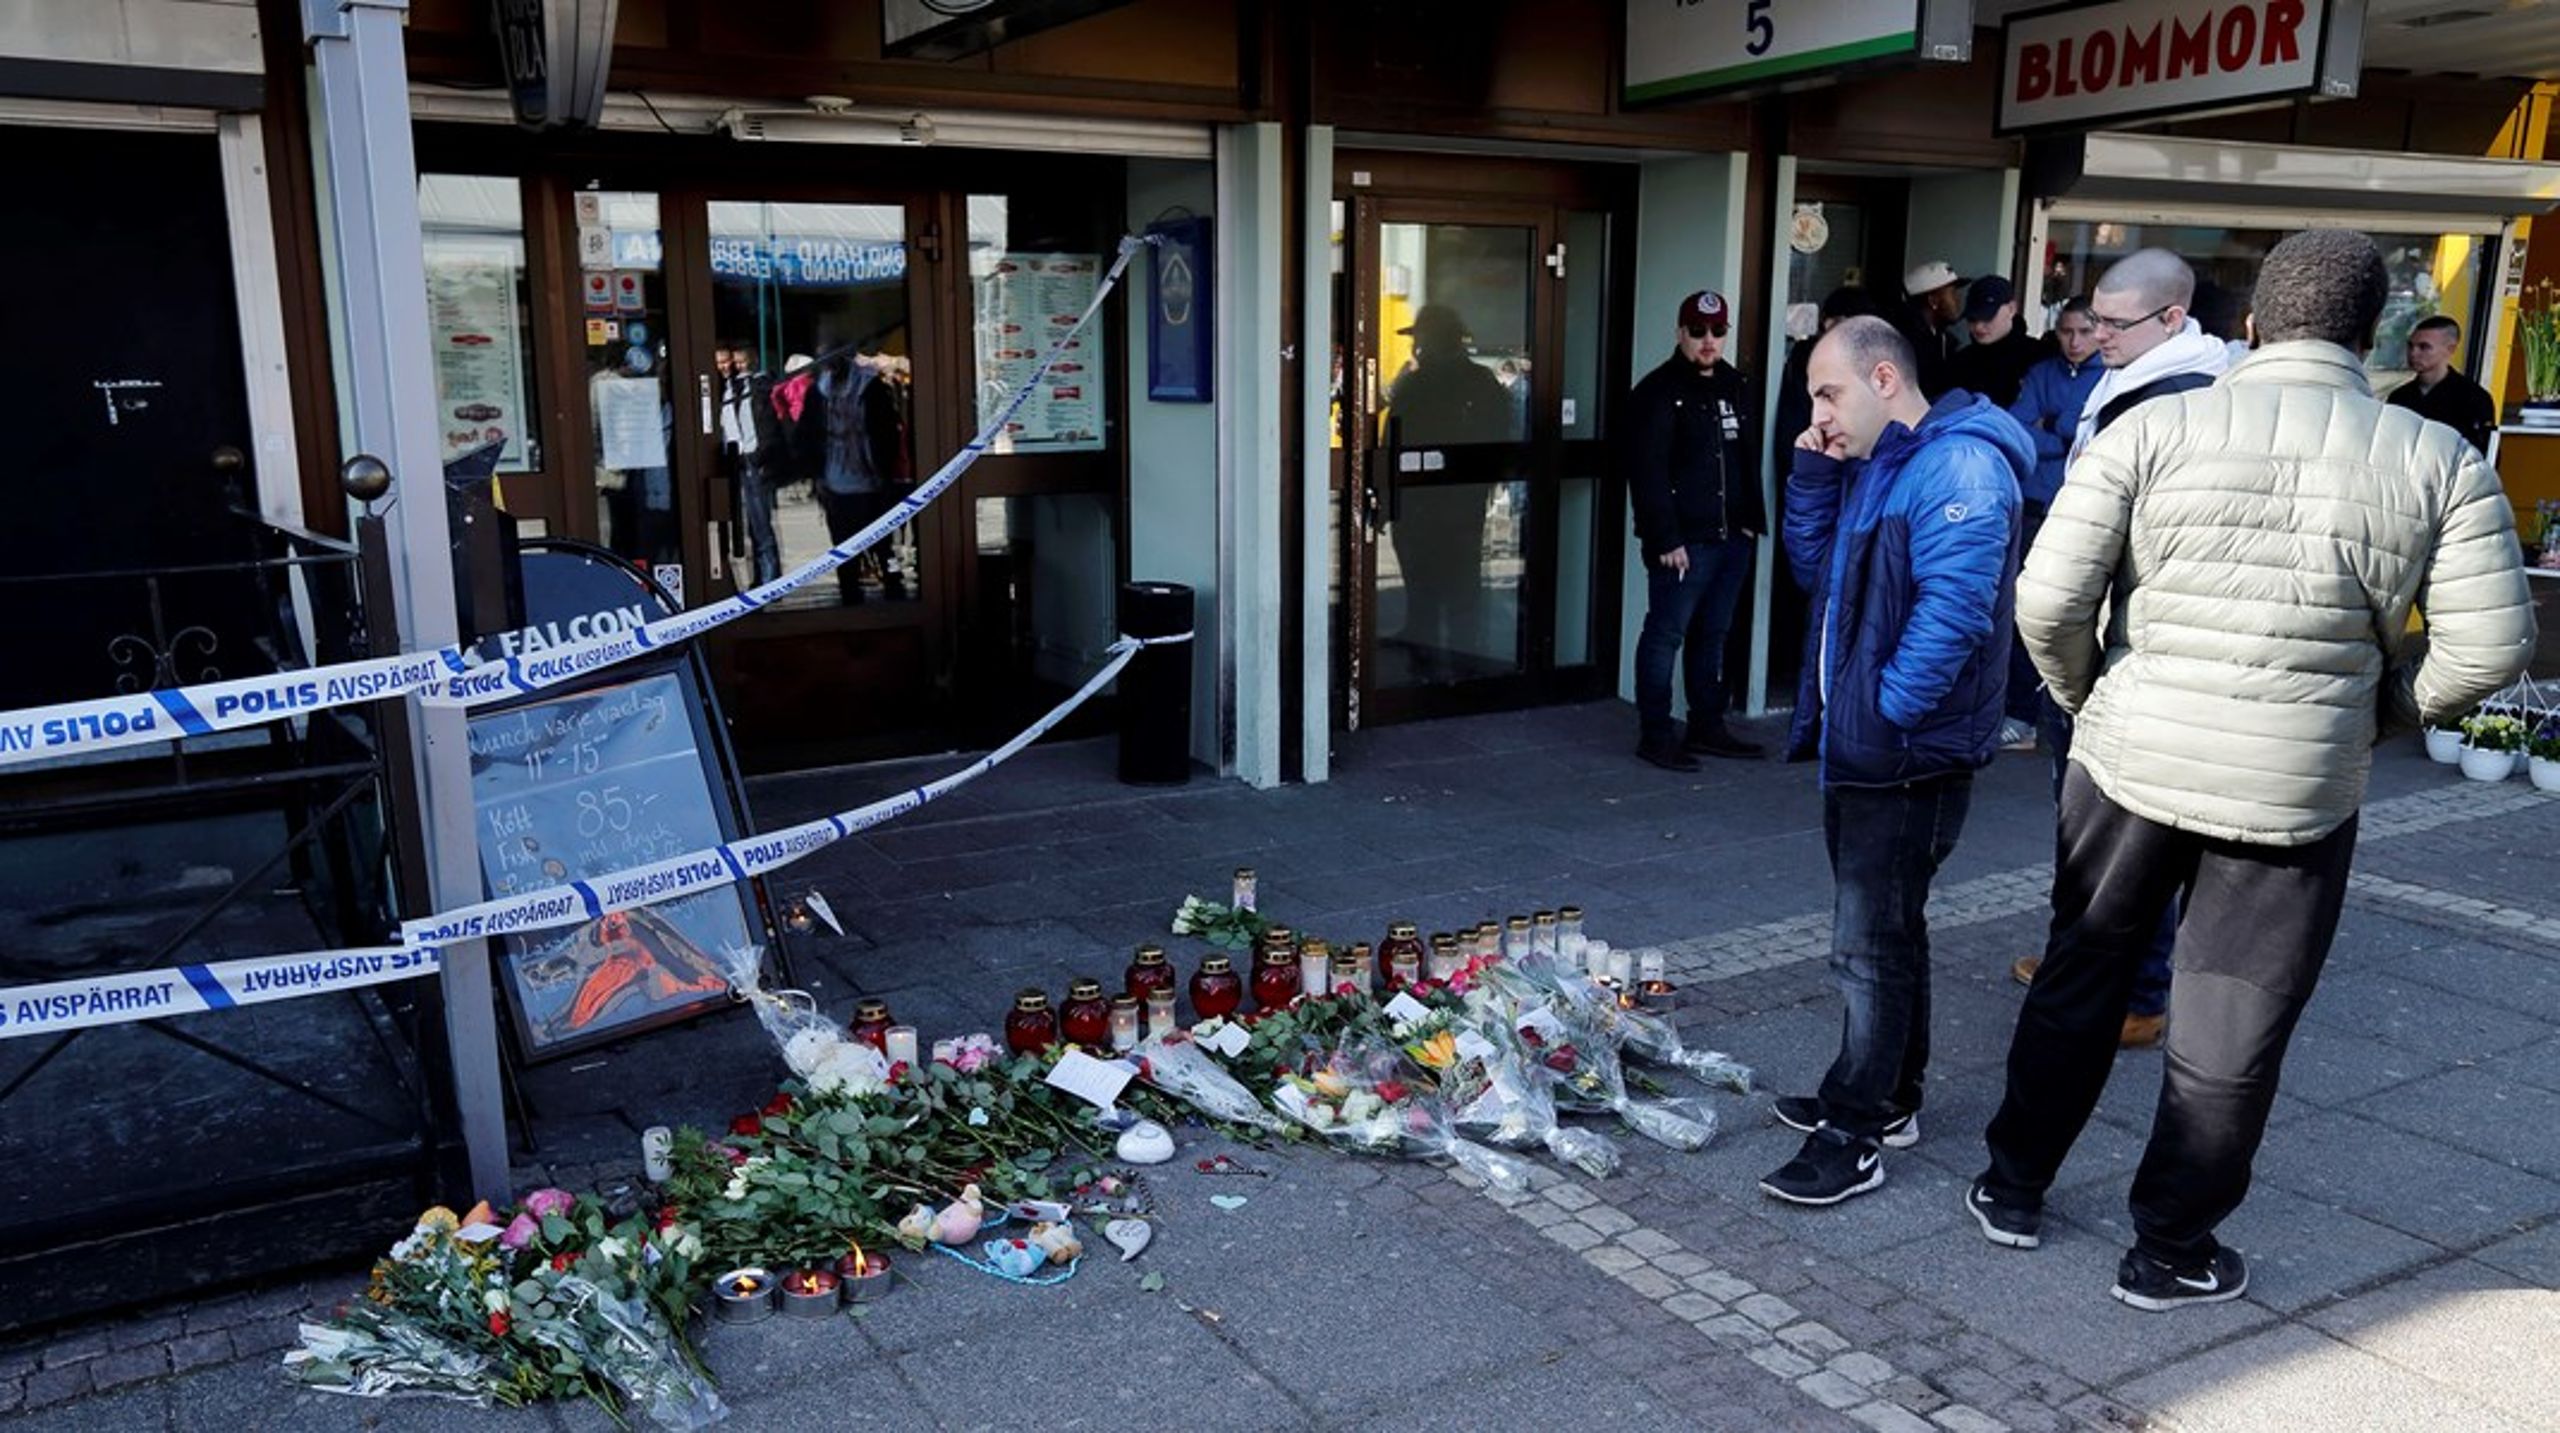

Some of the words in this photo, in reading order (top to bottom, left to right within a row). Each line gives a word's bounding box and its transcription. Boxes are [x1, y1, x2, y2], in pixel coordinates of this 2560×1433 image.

[1745, 0, 1774, 56] 5
[2017, 0, 2305, 103] BLOMMOR
[498, 604, 646, 658] FALCON
[215, 682, 319, 720] POLIS
[327, 659, 437, 702] AVSPÄRRAT
[528, 656, 575, 682] POLIS
[43, 707, 157, 746] POLIS
[676, 857, 724, 887] POLIS
[743, 841, 785, 868] POLIS
[485, 893, 576, 935] AVSPÄRRAT
[242, 954, 384, 994] AVSPÄRRAT
[15, 982, 174, 1025] AVSPÄRRAT
